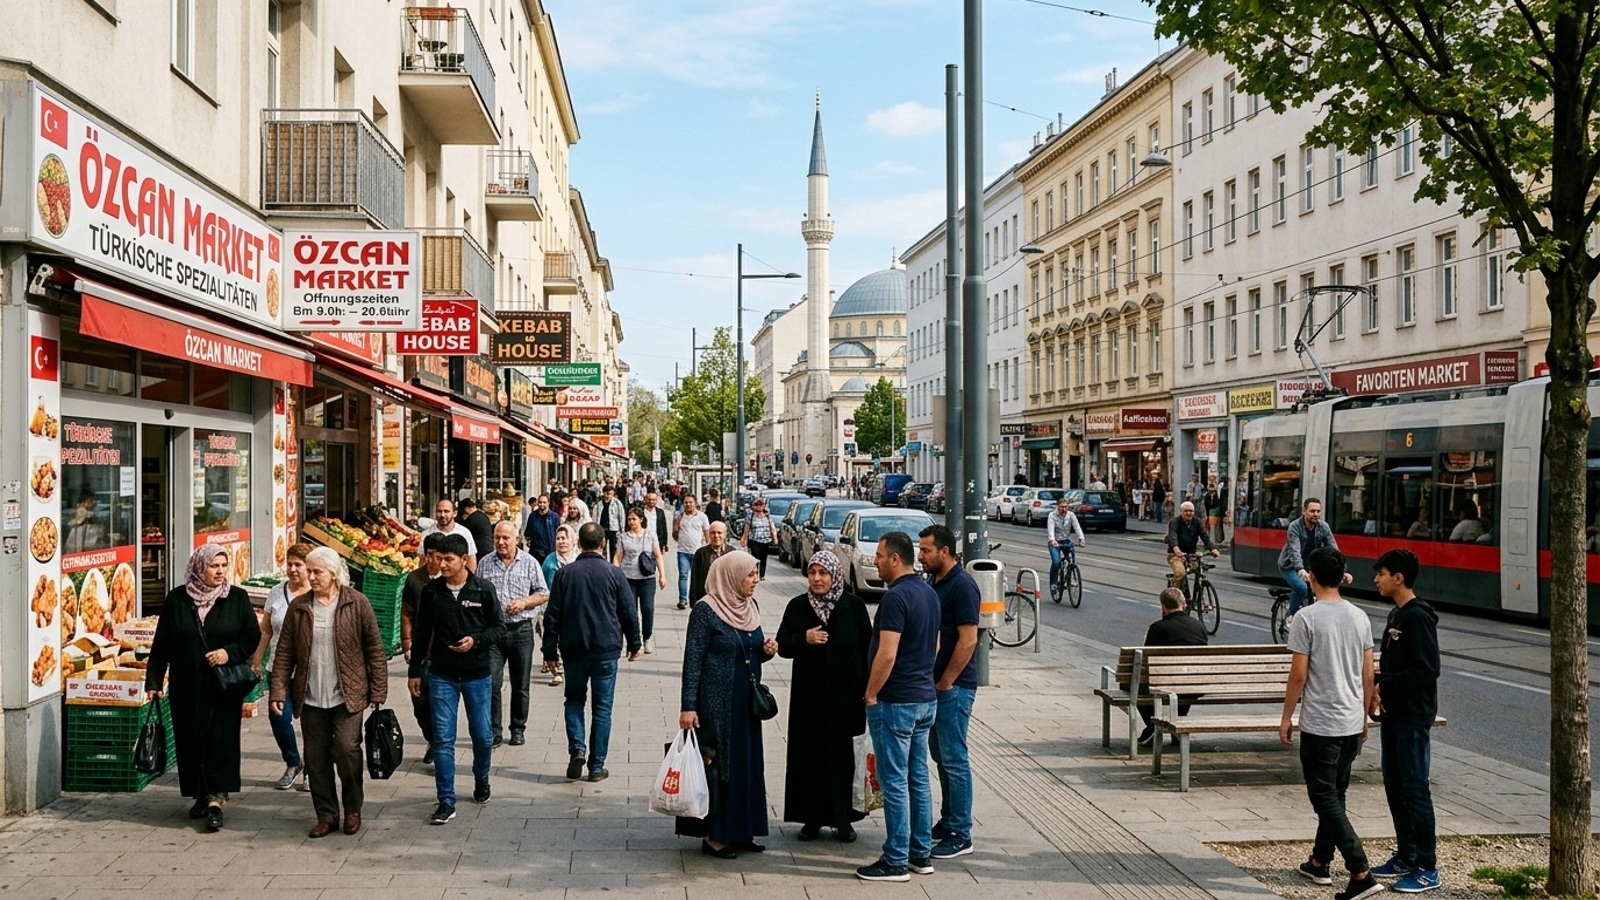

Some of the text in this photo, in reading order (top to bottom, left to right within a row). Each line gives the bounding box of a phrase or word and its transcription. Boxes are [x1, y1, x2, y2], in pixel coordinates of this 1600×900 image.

[79, 125, 264, 283] ÖZCAN MARKET
[293, 235, 409, 267] ÖZCAN
[293, 270, 409, 290] MARKET
[421, 317, 471, 332] EBAB
[498, 319, 562, 333] KEBAB
[403, 334, 471, 350] HOUSE
[498, 343, 562, 358] HOUSE
[1356, 368, 1415, 392] FAVORITEN
[1418, 361, 1469, 386] MARKET
[1406, 432, 1413, 447] 6
